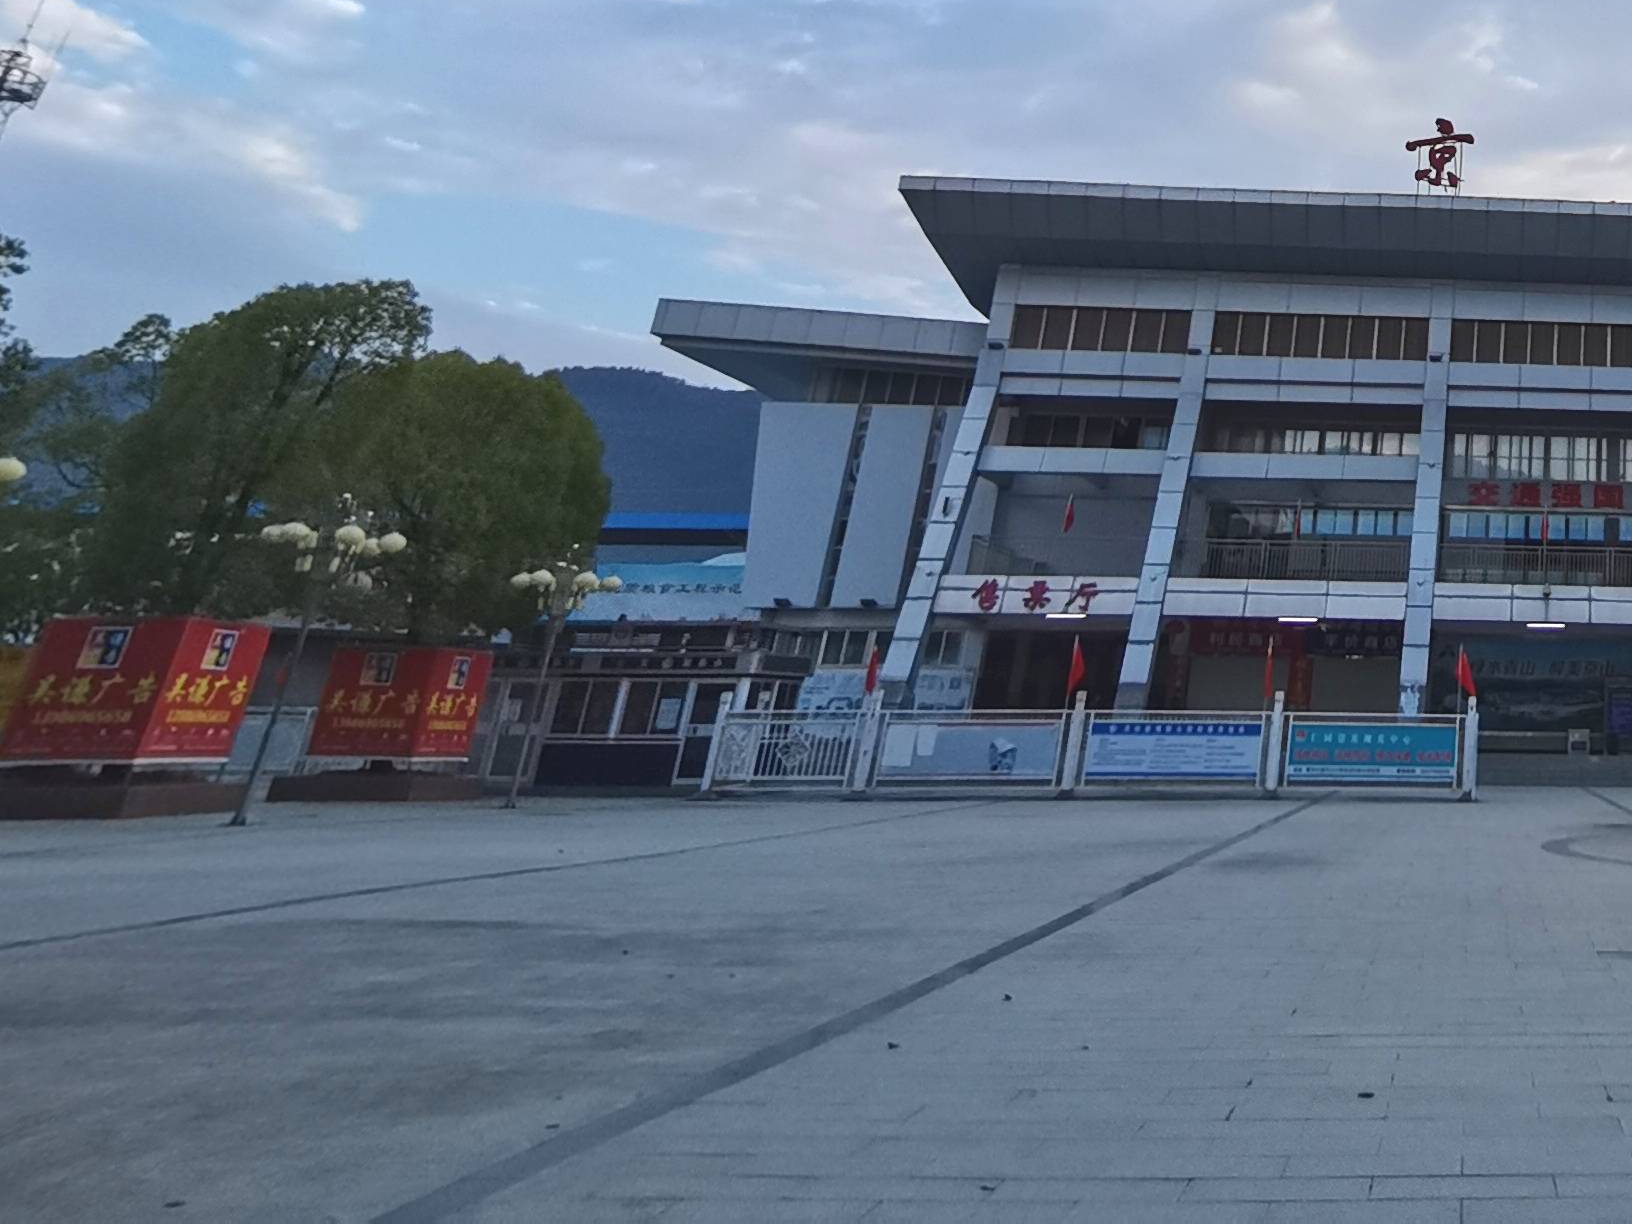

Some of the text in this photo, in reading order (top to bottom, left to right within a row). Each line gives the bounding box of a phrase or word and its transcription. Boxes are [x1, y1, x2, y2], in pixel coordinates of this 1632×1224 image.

[1467, 480, 1625, 510] 交通强国
[971, 578, 1100, 613] 售票厅
